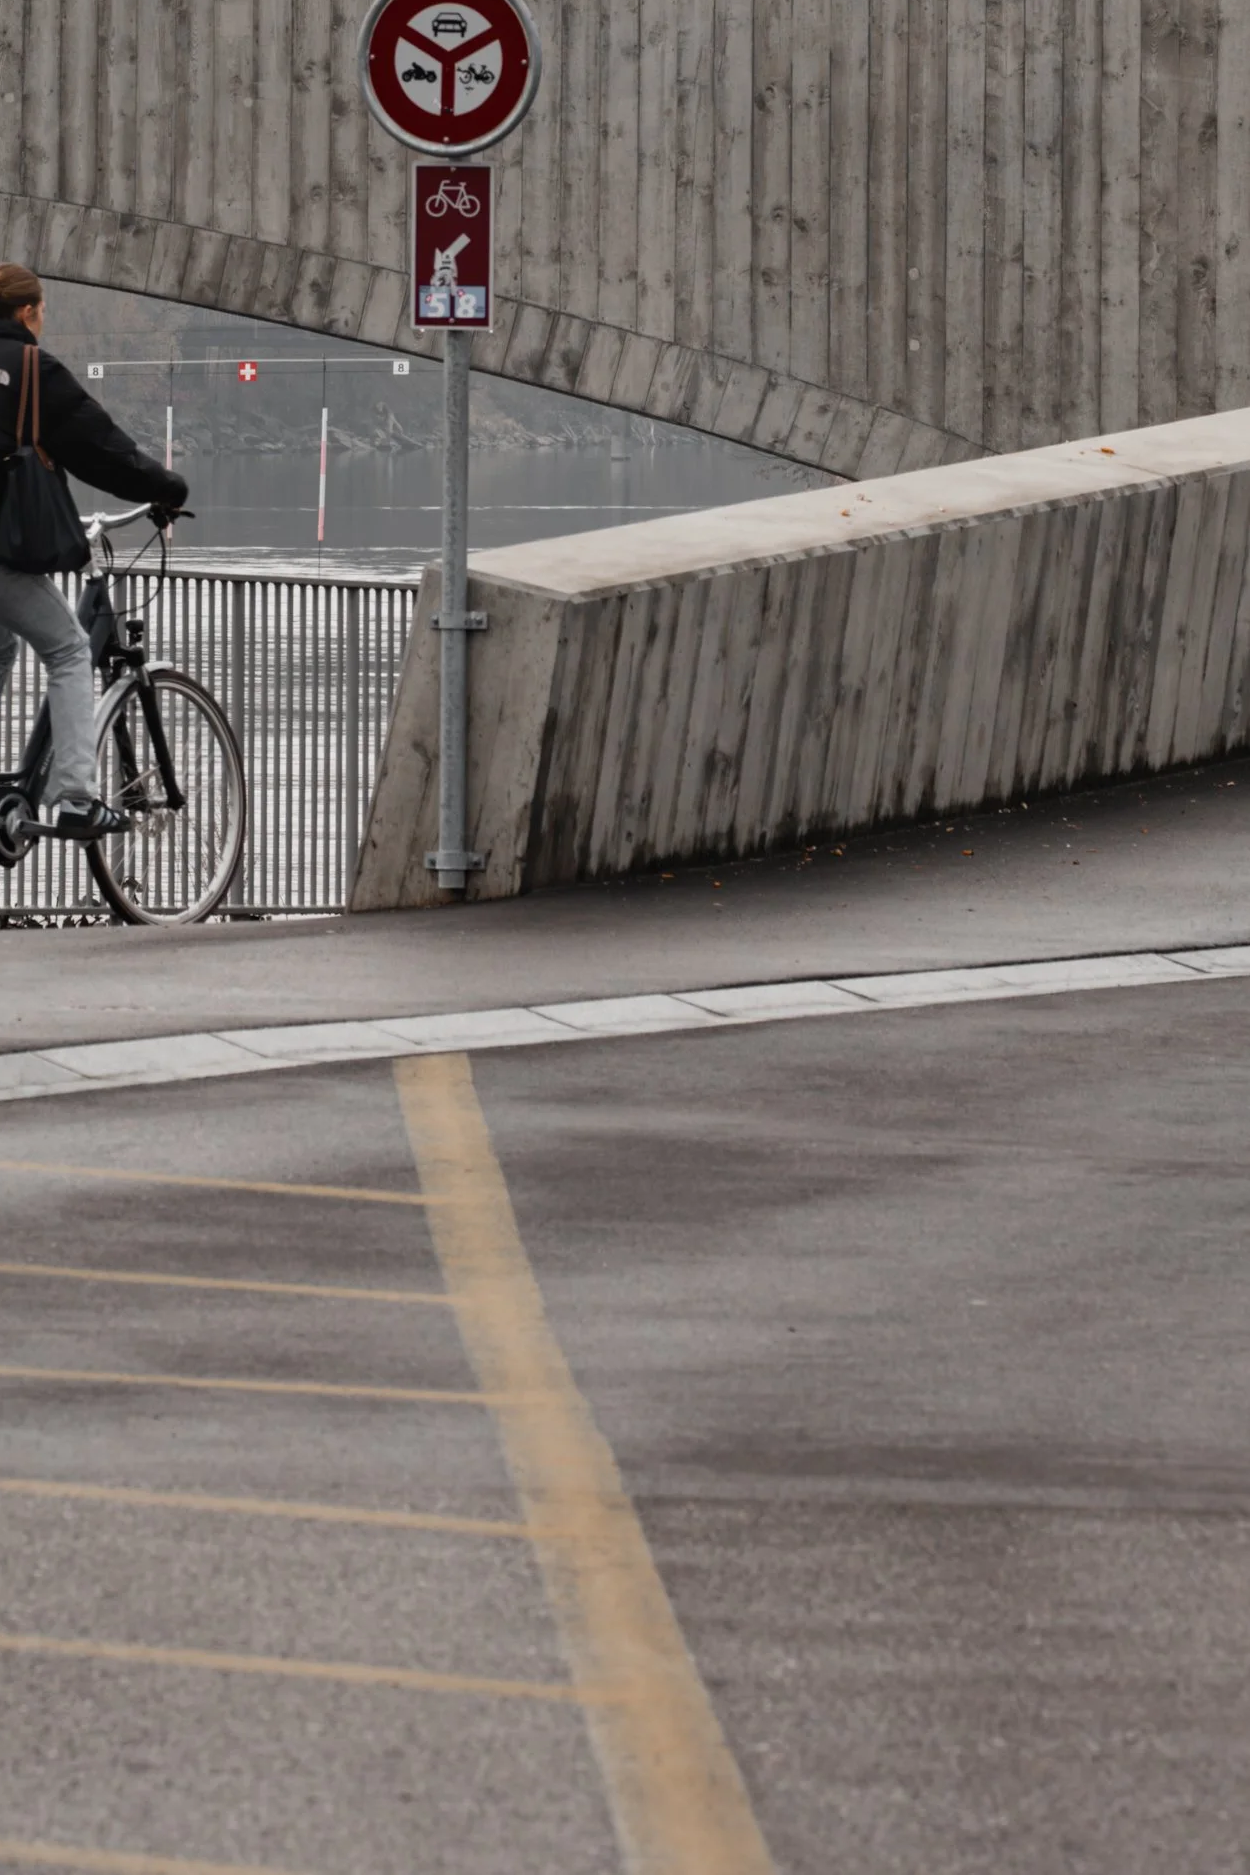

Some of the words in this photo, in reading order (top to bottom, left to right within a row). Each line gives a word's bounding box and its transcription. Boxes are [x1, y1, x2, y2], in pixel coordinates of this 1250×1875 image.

[426, 292, 447, 318] 5
[455, 293, 477, 318] 8
[92, 366, 99, 376] 8
[398, 363, 405, 373] 8
